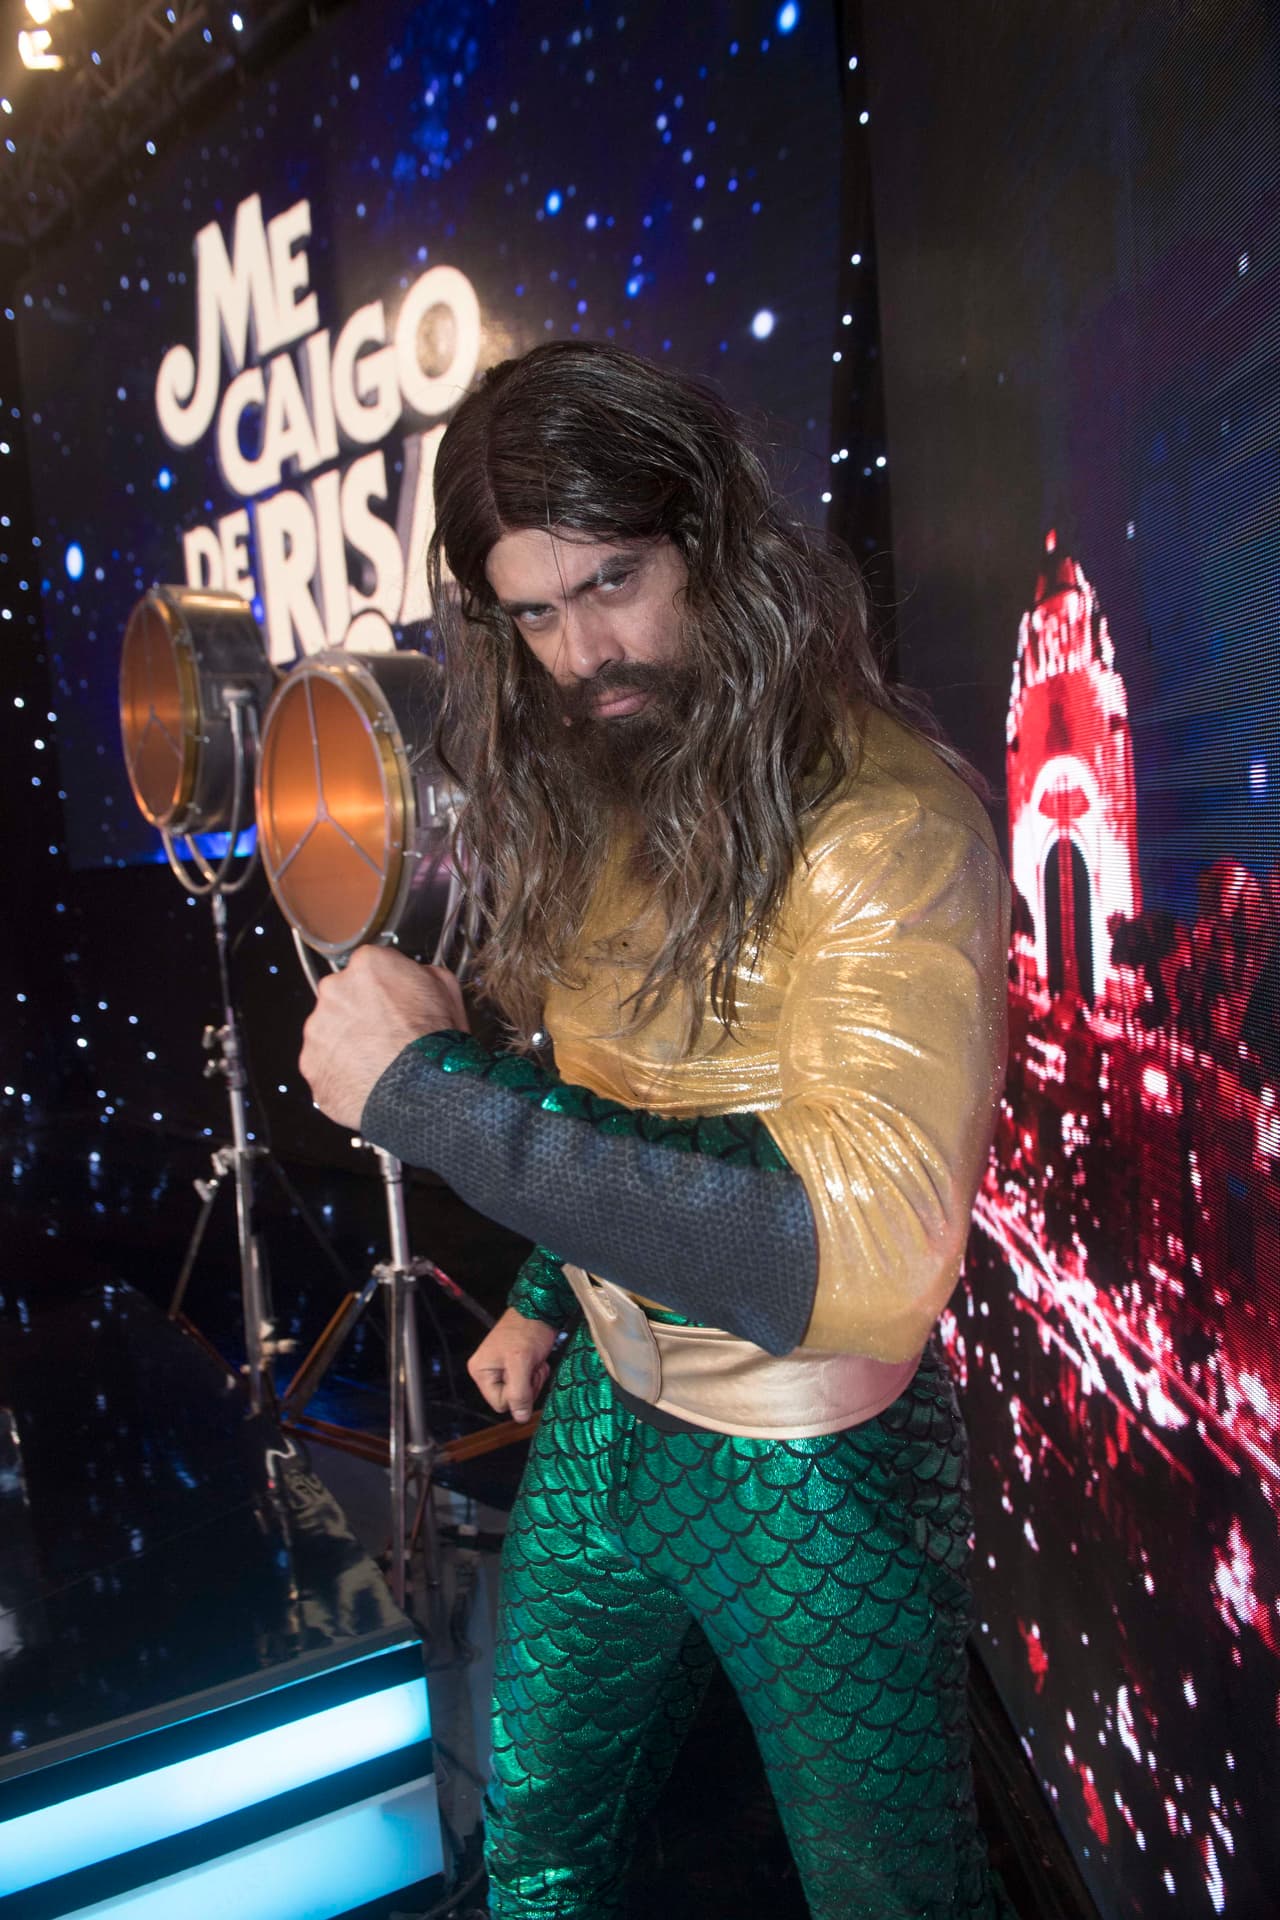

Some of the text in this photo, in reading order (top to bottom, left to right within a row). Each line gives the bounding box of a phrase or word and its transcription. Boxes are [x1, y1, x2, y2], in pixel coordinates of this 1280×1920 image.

[156, 193, 319, 447] ME
[218, 264, 481, 496] CAIGO
[184, 508, 256, 600] DE
